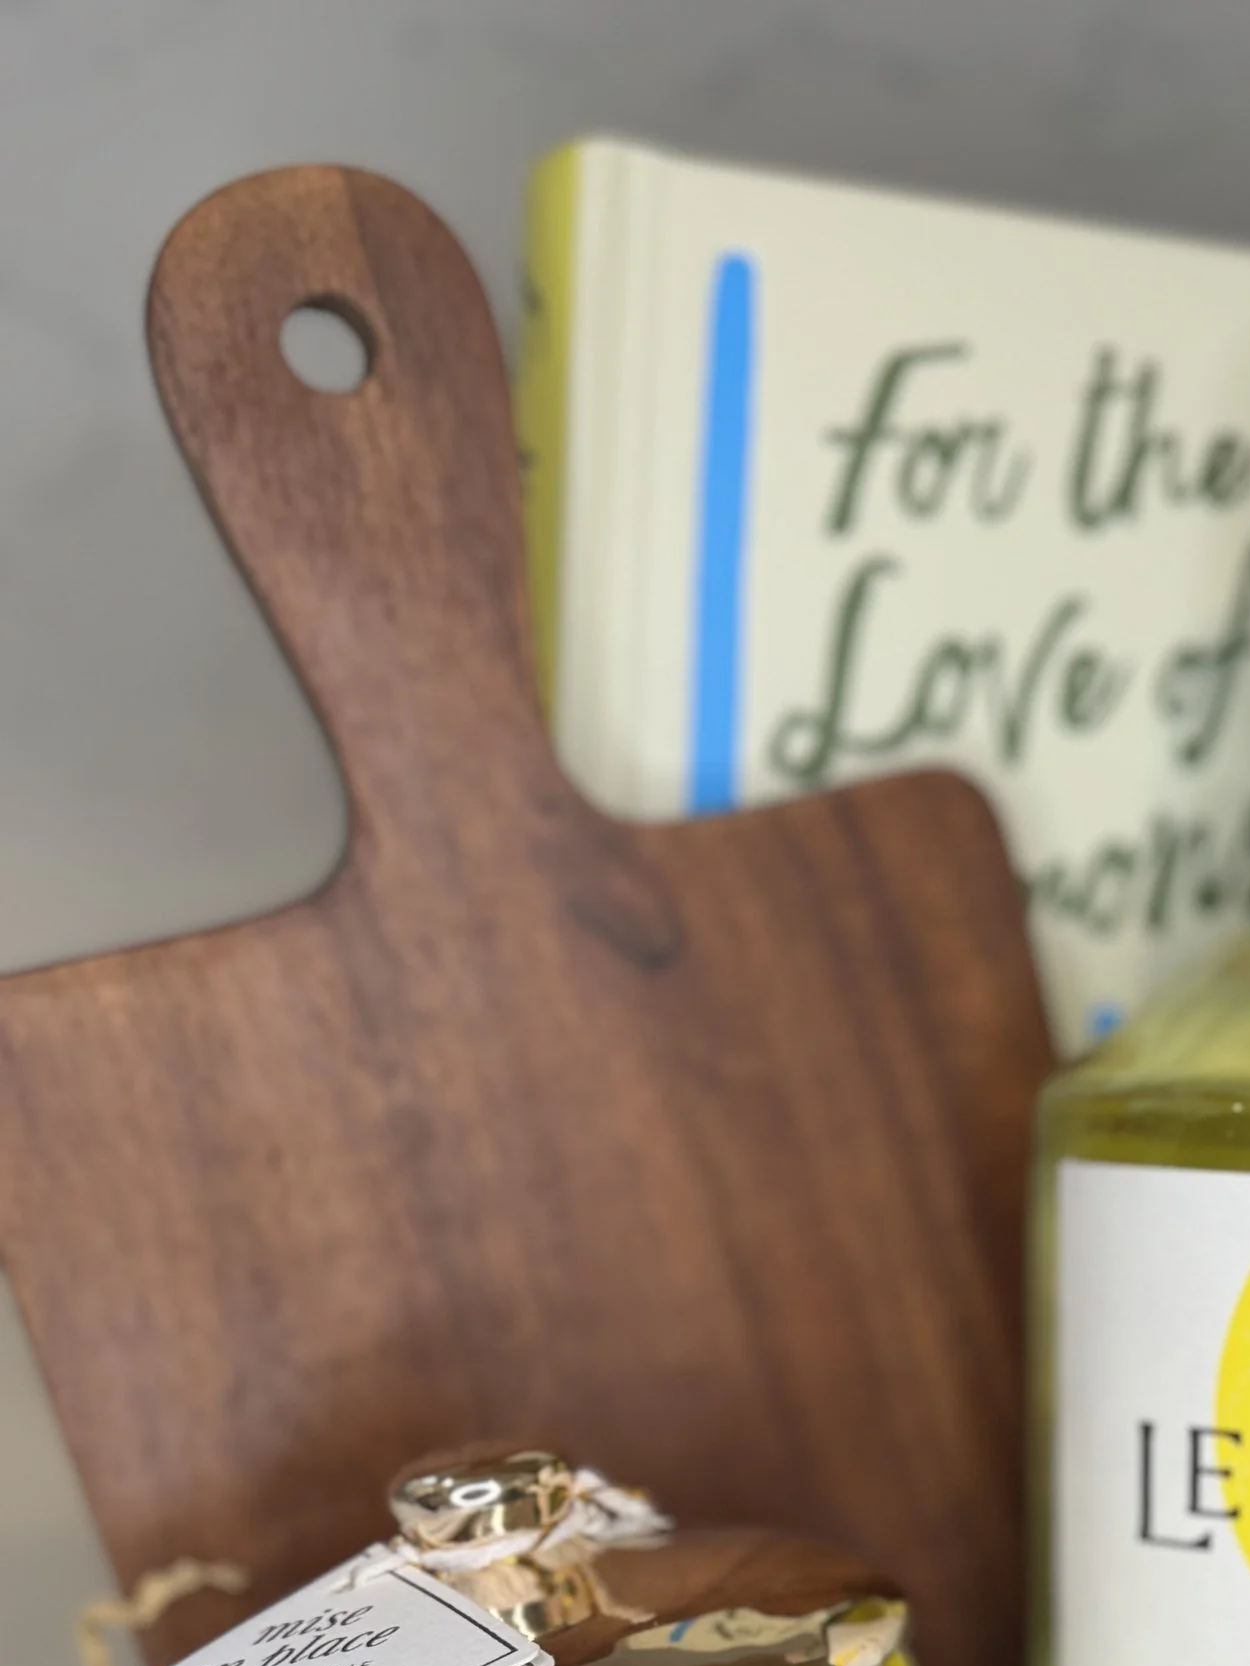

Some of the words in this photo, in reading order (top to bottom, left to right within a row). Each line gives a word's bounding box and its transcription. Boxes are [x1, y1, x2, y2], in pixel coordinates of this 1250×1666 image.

[826, 341, 1034, 537] For
[767, 553, 1133, 786] Love
[1137, 1421, 1243, 1551] LE
[252, 1605, 374, 1646] mise
